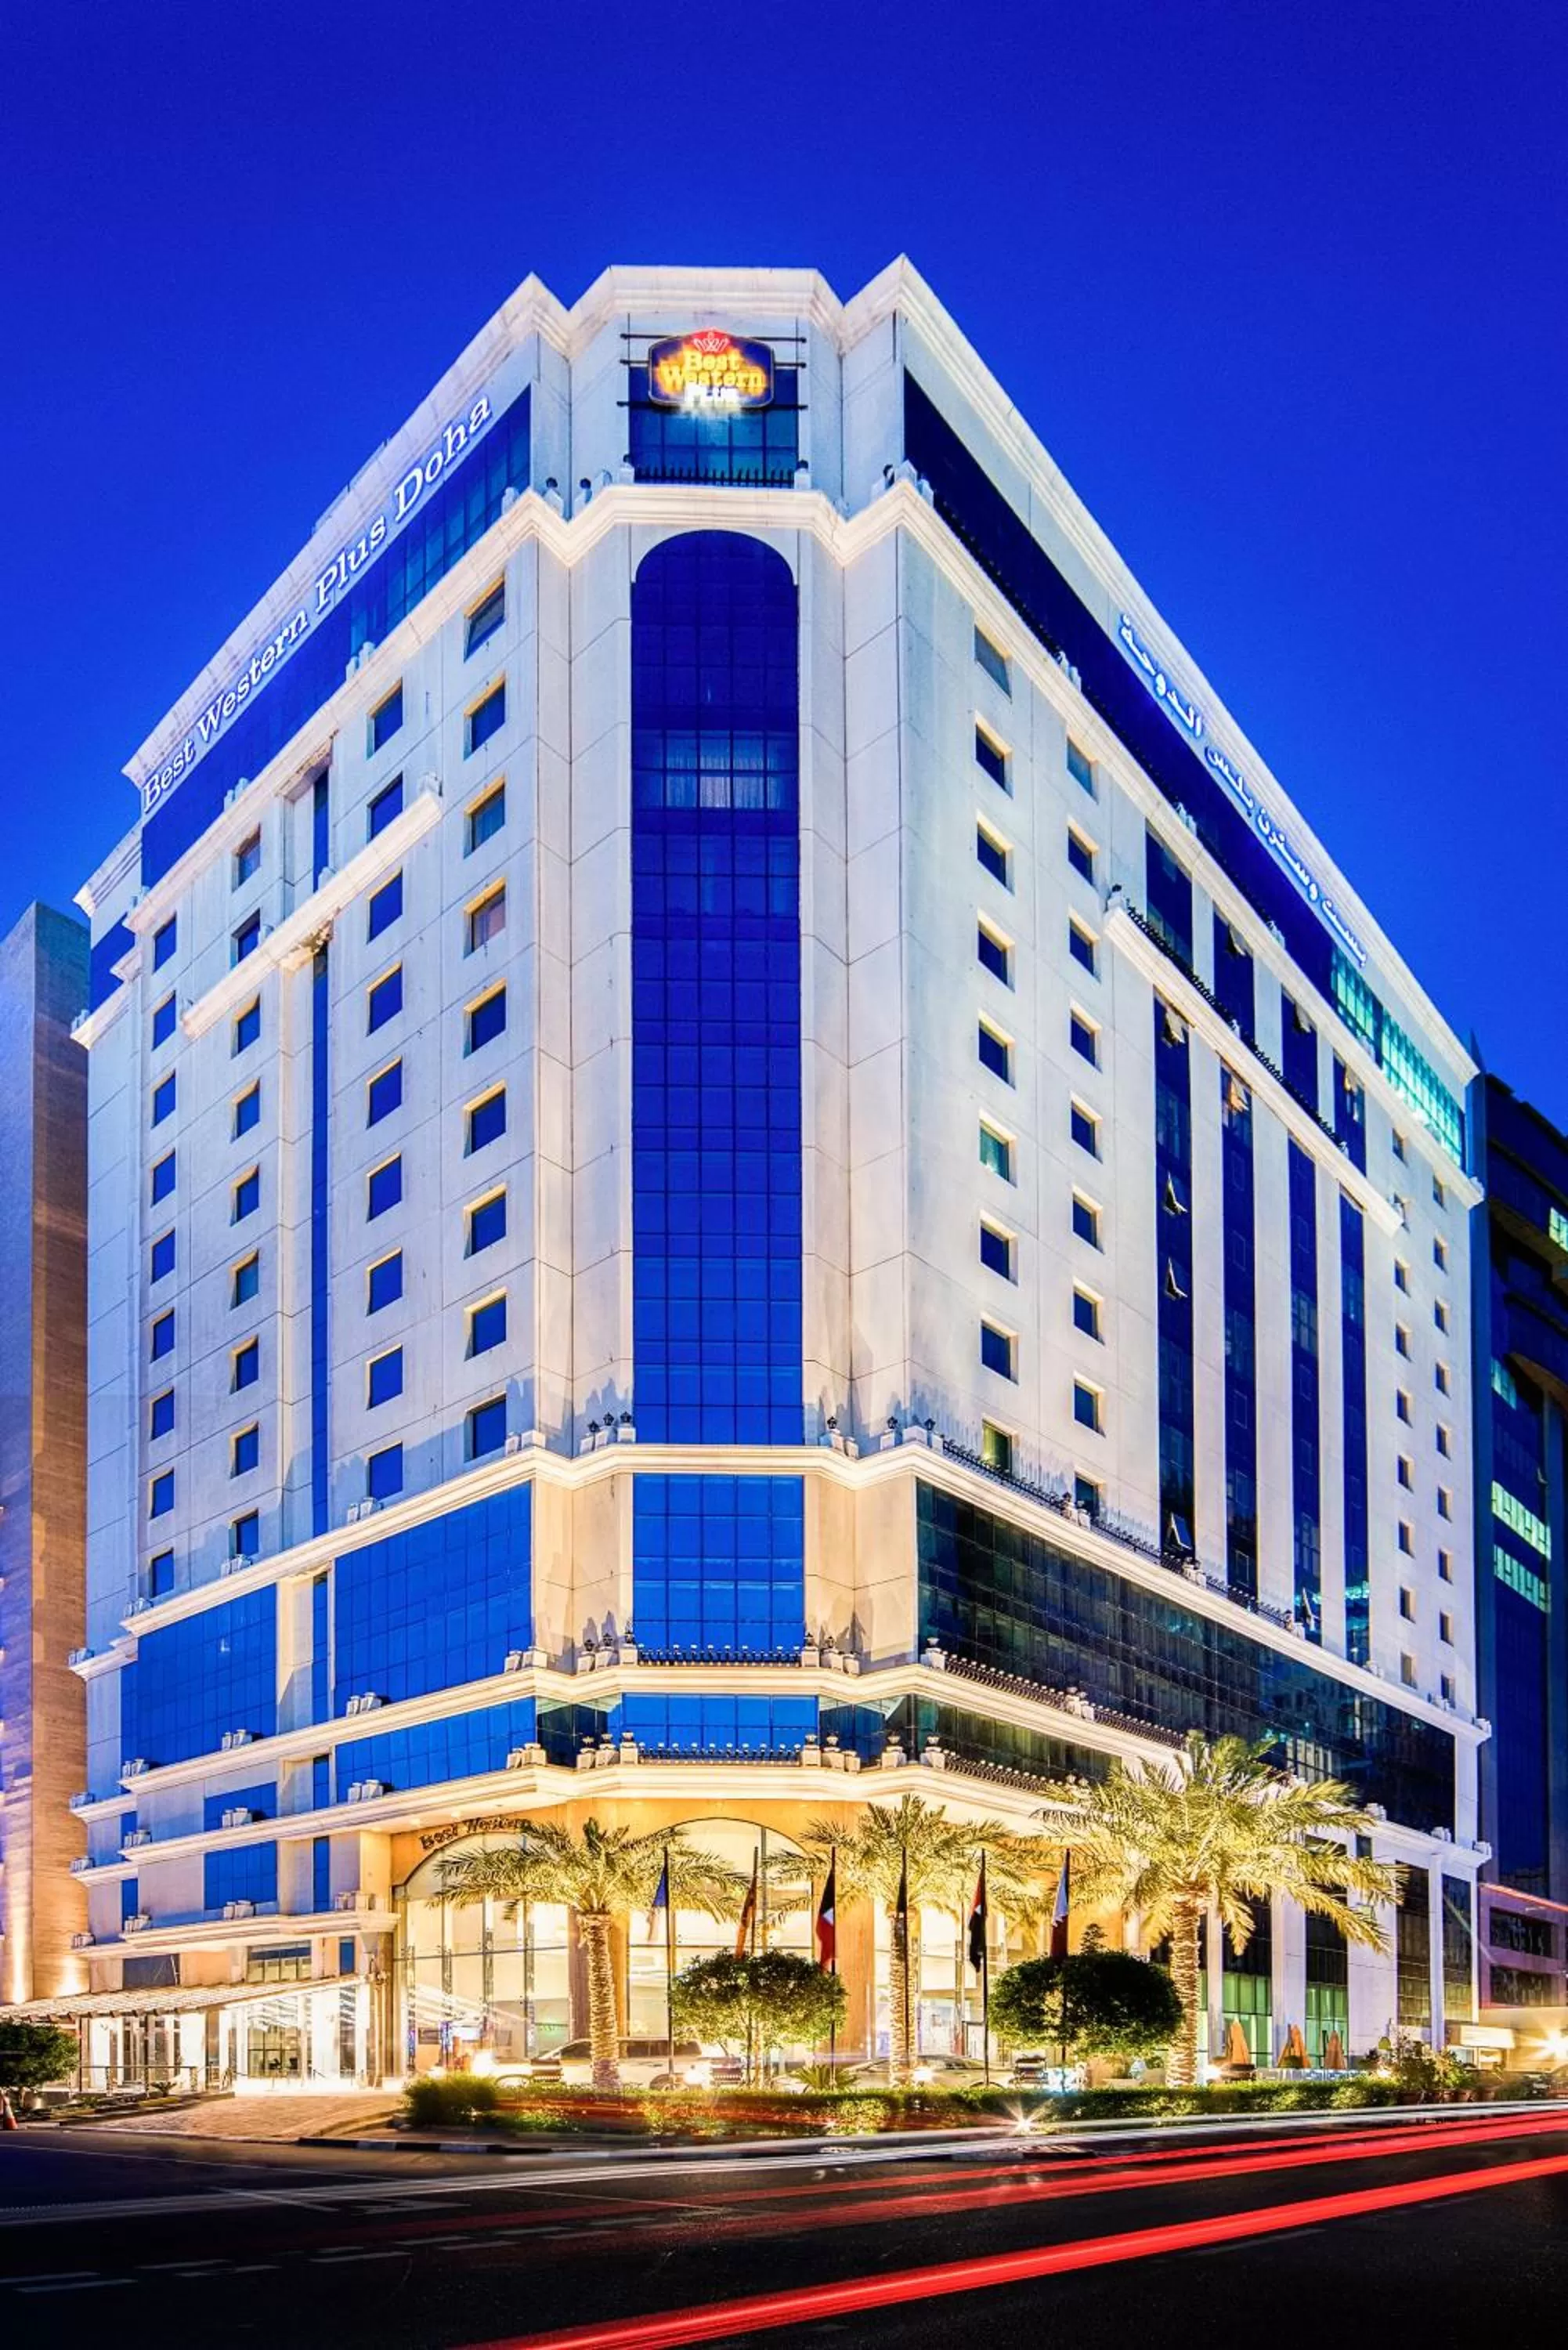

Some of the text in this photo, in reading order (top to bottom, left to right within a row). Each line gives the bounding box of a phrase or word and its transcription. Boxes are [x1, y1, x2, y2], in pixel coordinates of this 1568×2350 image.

[684, 346, 739, 371] Best
[658, 361, 765, 396] Western
[143, 396, 490, 813] Best Western Plus Doha
[1121, 613, 1367, 967] بست وسترن بلس الدوحة
[419, 1823, 458, 1849] Best
